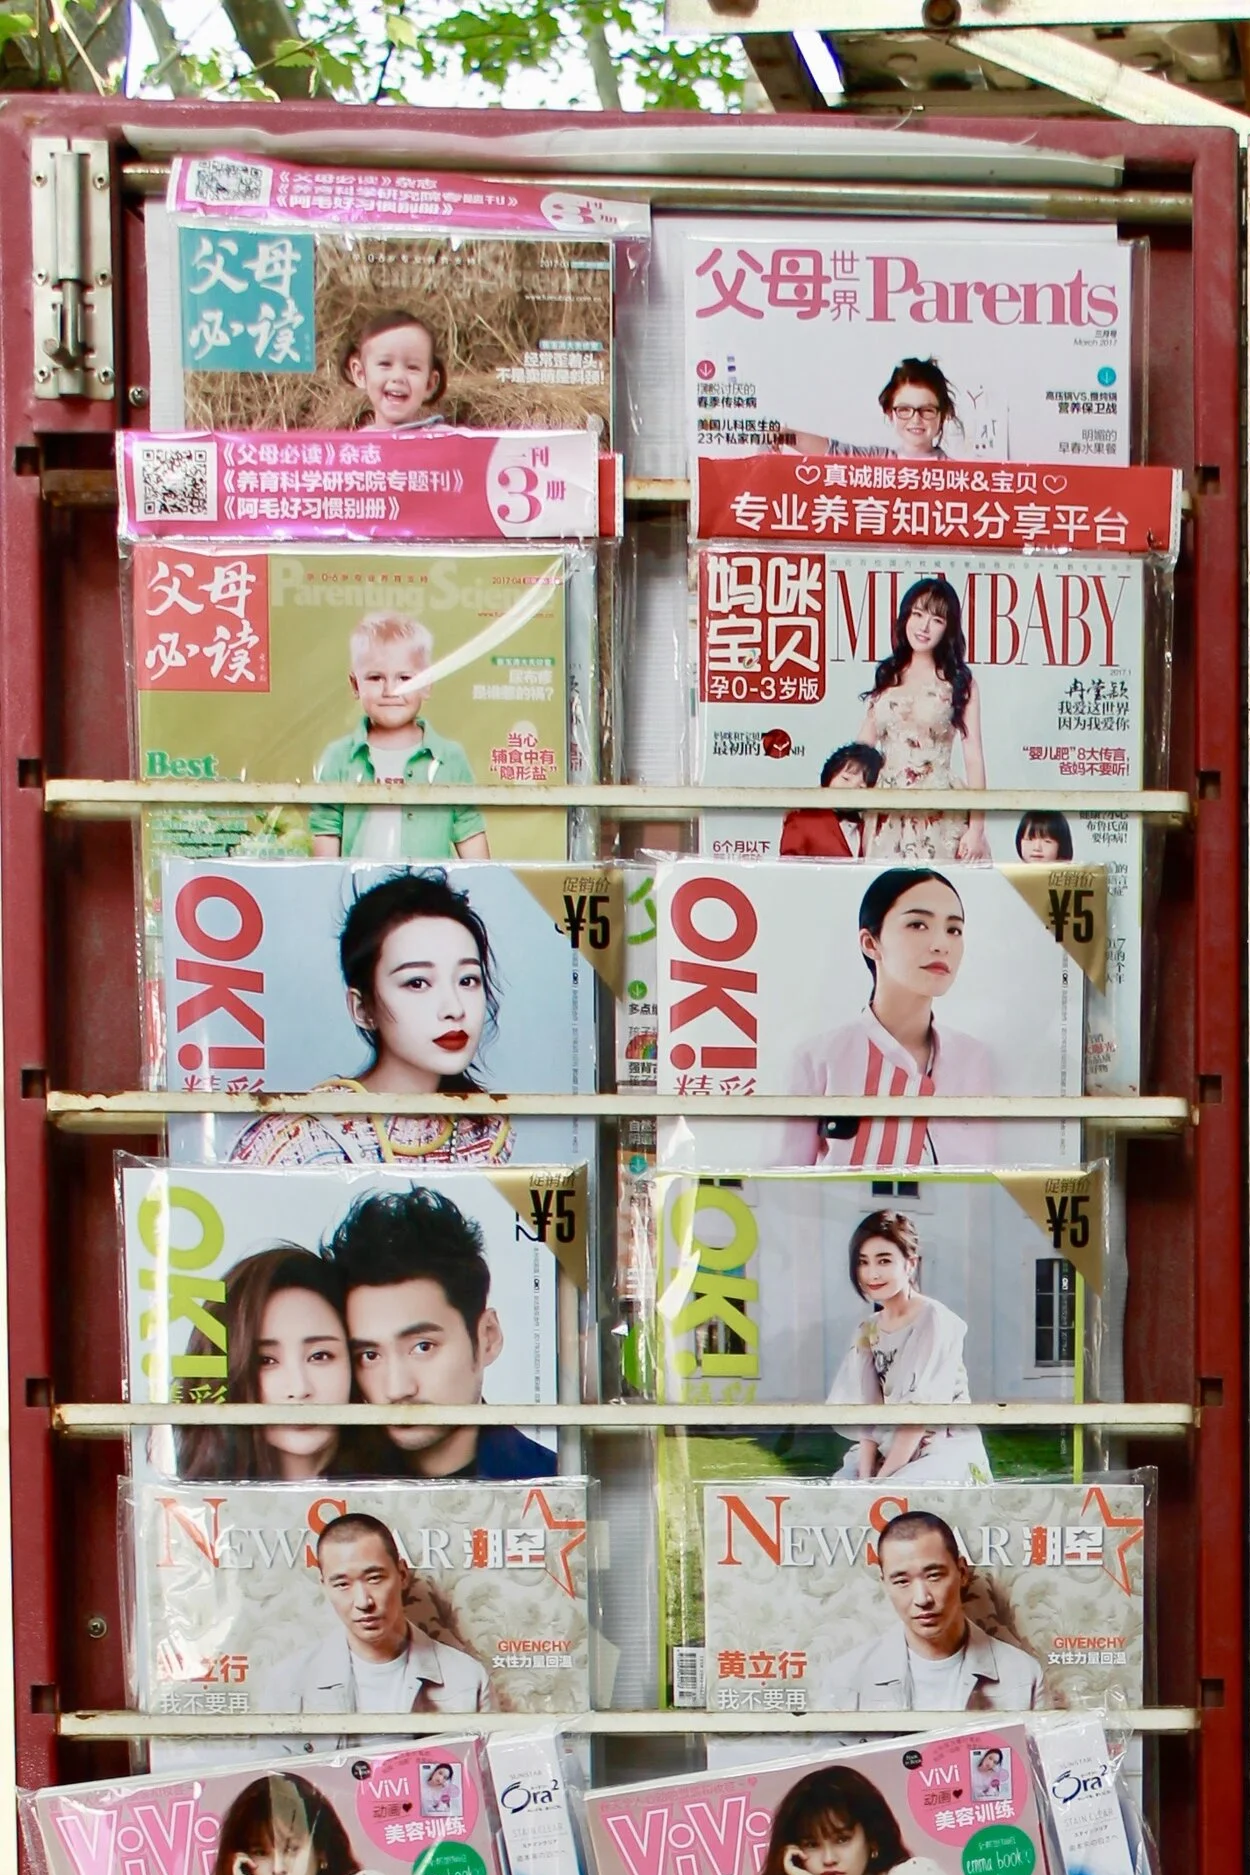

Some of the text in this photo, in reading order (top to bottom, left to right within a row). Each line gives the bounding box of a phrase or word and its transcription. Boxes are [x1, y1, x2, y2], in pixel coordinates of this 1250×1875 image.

[189, 236, 302, 296] 父母
[696, 247, 833, 320] 父母
[830, 249, 860, 323] 世界
[865, 255, 1118, 327] Parents
[189, 302, 304, 366] 必读
[697, 396, 757, 409] 春季传染病
[1058, 402, 1118, 415] 营养保卫战
[697, 419, 781, 432] 美国儿科医生的
[223, 442, 382, 467] 《父母必读》杂志
[1058, 442, 1117, 455] 早春水果餐
[222, 469, 465, 494] 《养育科学研究院专题刊》
[823, 464, 1037, 494] 真诚服务妈咪&宝贝
[497, 465, 541, 524] 3
[223, 496, 401, 522] 《阿毛好习惯别册》
[730, 491, 1129, 545] 专业养育知识分享平台
[706, 557, 822, 614] 妈咪
[145, 620, 259, 684] 必读
[706, 616, 820, 673] 宝贝
[710, 675, 819, 701] 孕0-3岁版
[1058, 701, 1130, 716] 我爱这世界
[1058, 716, 1130, 733] 因为我爱你
[508, 733, 537, 748] 当心
[147, 751, 218, 779] Best
[492, 749, 555, 765] 辅食中有
[713, 840, 770, 854] 6个月以下
[563, 876, 611, 893] 促销价
[1048, 890, 1094, 943] ¥5
[175, 876, 265, 1071] OK!
[670, 877, 757, 1070] OK!
[497, 1640, 571, 1652] GIVENCHY
[491, 1655, 572, 1669] 女性力量回温
[717, 1651, 807, 1680] 黄立行
[159, 1692, 250, 1714] 我不要再
[717, 1689, 806, 1711] 我不要再
[920, 1765, 960, 1787] ViVi
[935, 1800, 1015, 1831] 美容训练
